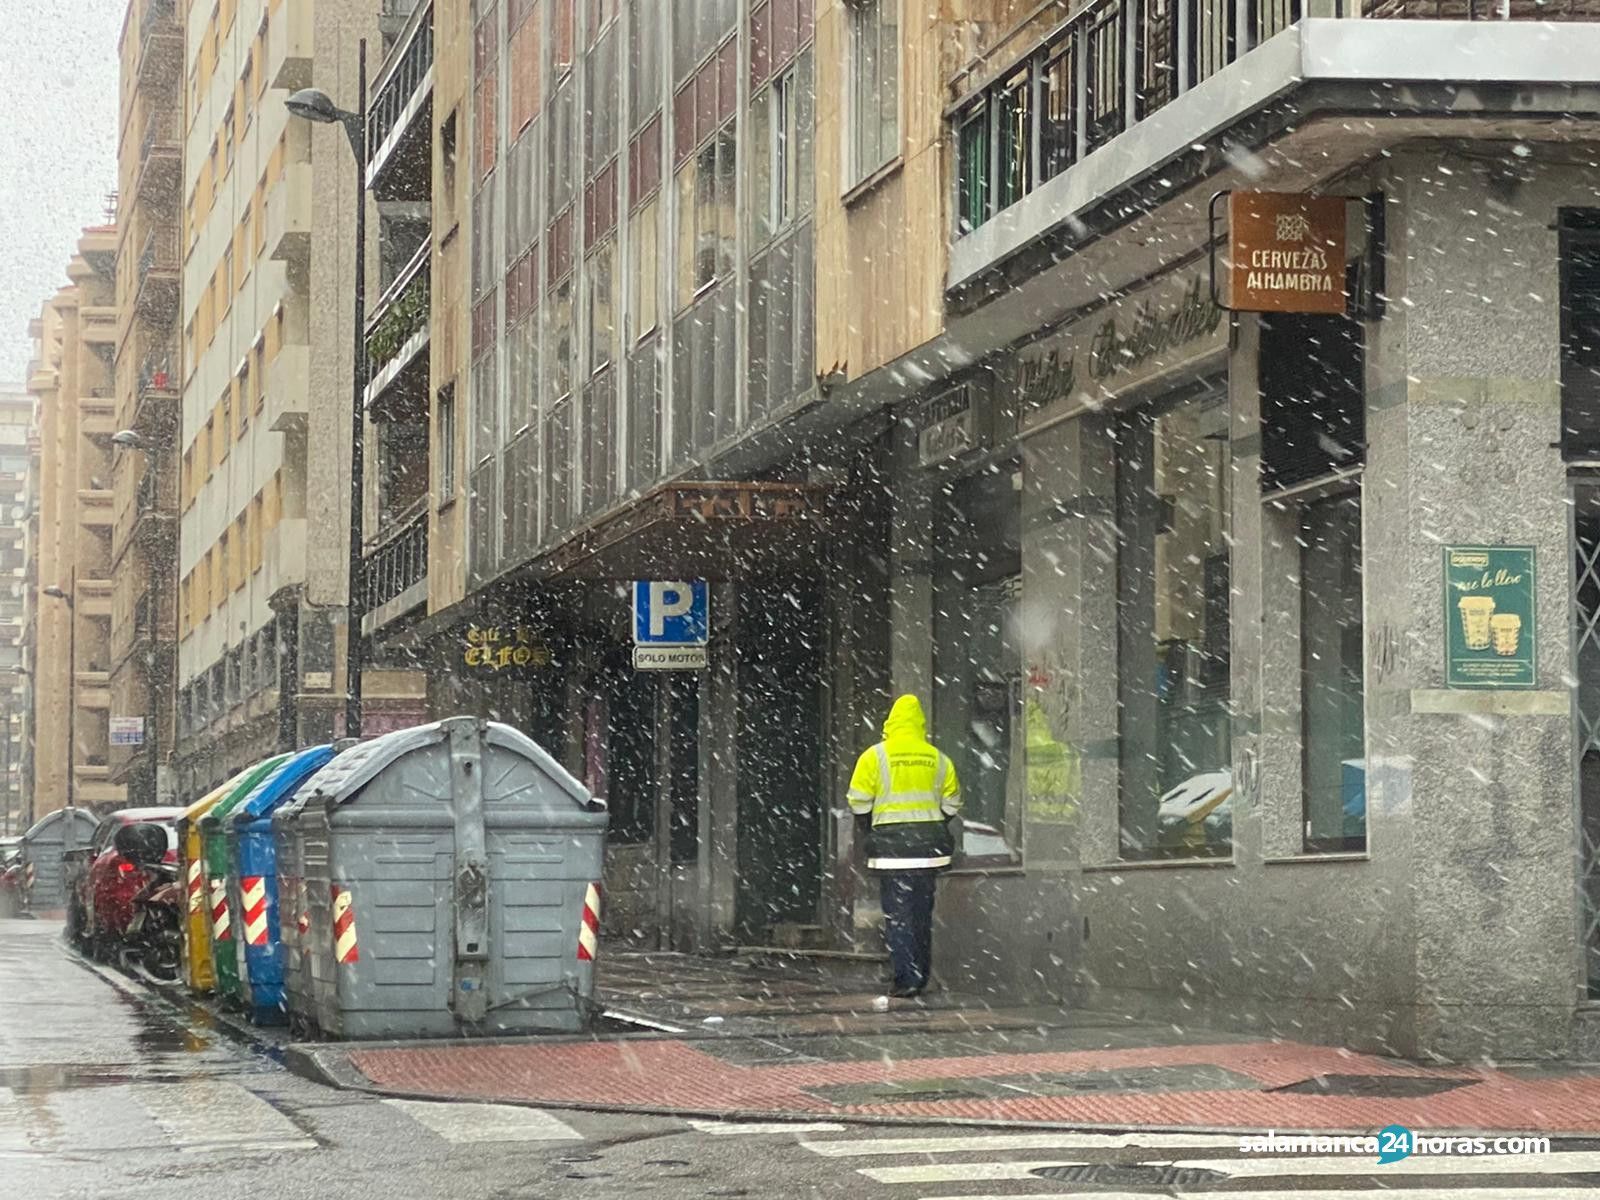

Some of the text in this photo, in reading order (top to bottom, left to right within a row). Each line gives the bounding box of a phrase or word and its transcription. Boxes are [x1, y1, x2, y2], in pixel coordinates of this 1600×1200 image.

[1252, 249, 1328, 270] CERVEZAS
[1247, 271, 1329, 291] ALHAMBRA
[649, 581, 693, 636] P
[638, 654, 666, 663] SOLO
